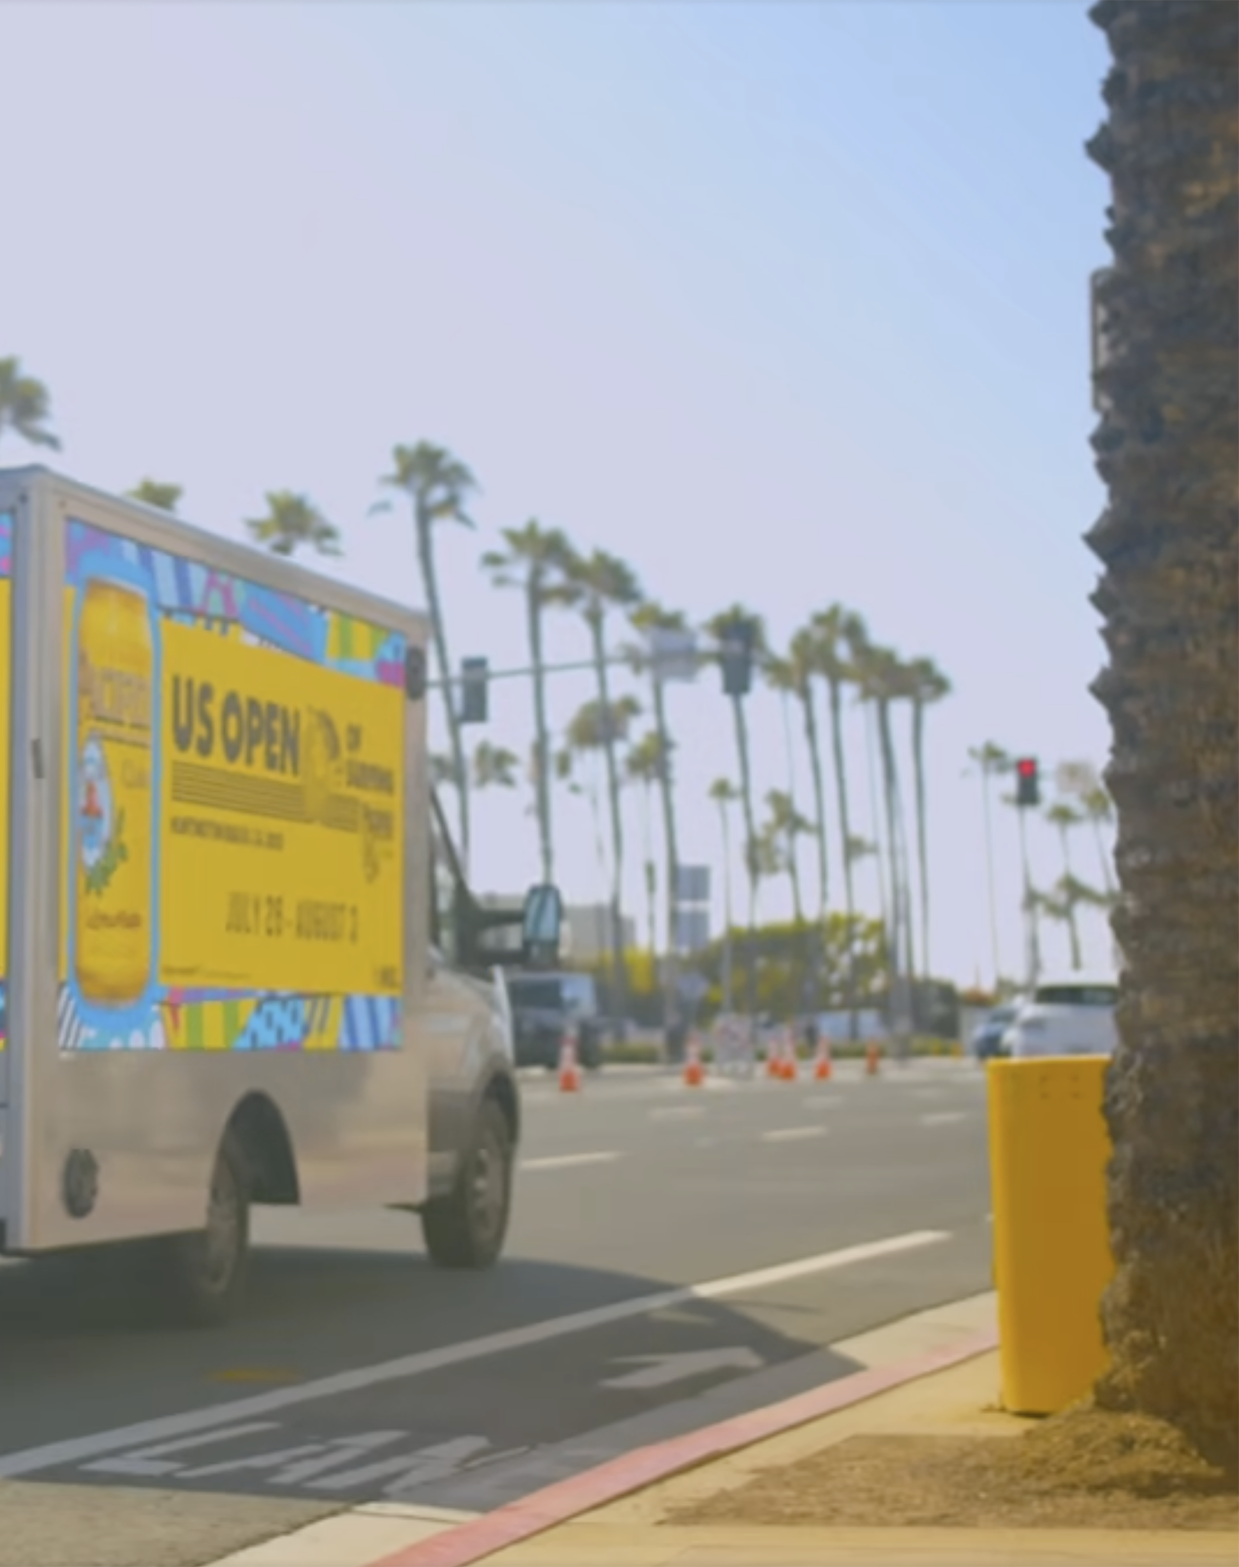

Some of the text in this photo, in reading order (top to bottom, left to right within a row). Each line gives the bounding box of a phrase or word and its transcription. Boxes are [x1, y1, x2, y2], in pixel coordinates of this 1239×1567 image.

[172, 673, 301, 778] US OPEN
[77, 1422, 541, 1492] LAN
